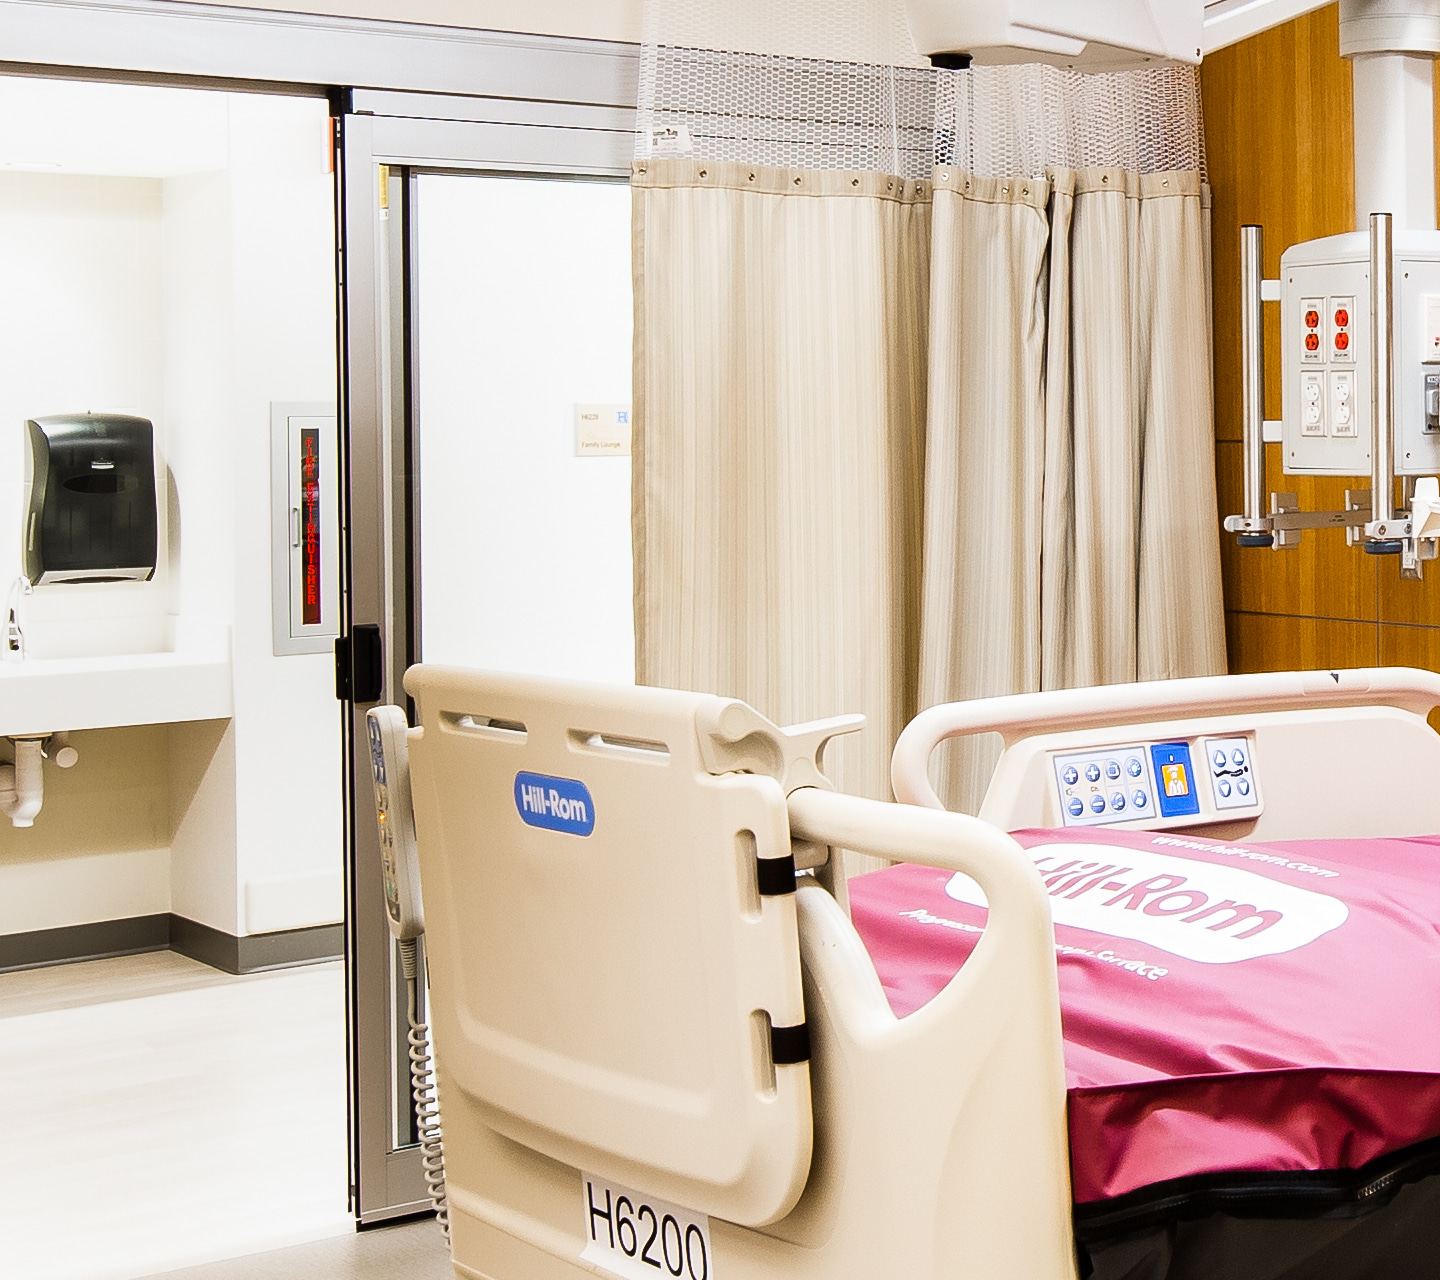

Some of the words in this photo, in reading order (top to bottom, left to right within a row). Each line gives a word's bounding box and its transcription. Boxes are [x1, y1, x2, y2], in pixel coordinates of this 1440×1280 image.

[305, 437, 315, 477] FIRE
[306, 482, 316, 605] EXTINGUISHER
[521, 784, 587, 823] Hill-Rom
[1035, 857, 1284, 940] Hill-Rom
